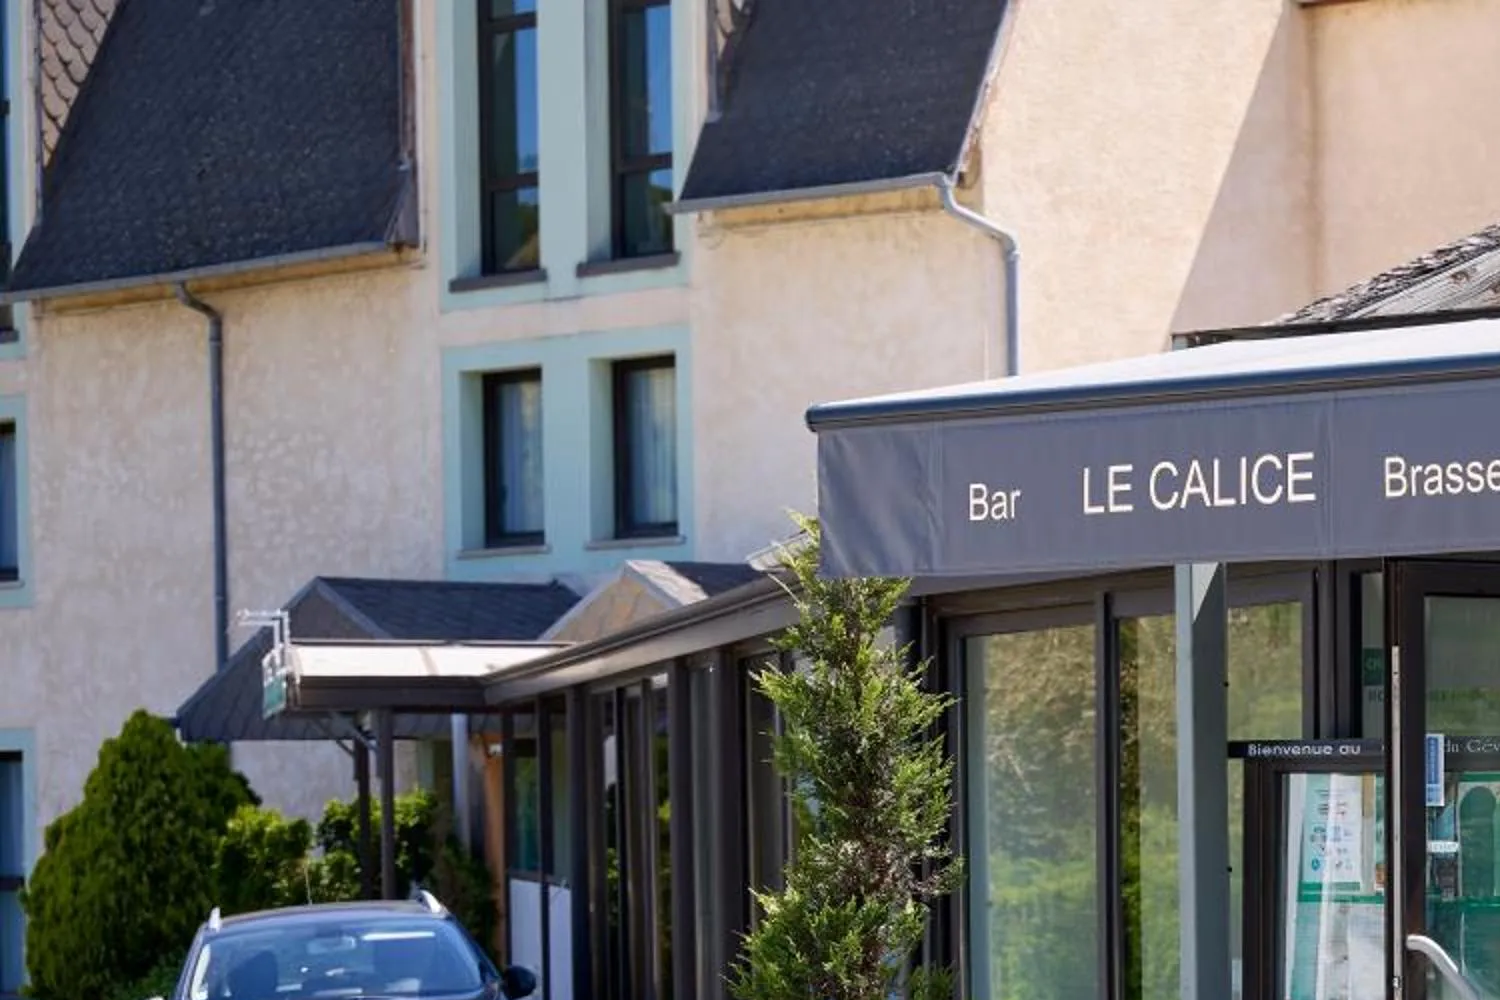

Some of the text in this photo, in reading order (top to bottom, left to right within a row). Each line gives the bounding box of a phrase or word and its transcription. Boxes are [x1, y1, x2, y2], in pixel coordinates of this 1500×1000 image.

[969, 483, 1022, 521] Bar
[1083, 463, 1134, 515] LE
[1149, 454, 1316, 511] CALICE
[1247, 743, 1334, 757] Bienvenue
[1339, 744, 1361, 755] au
